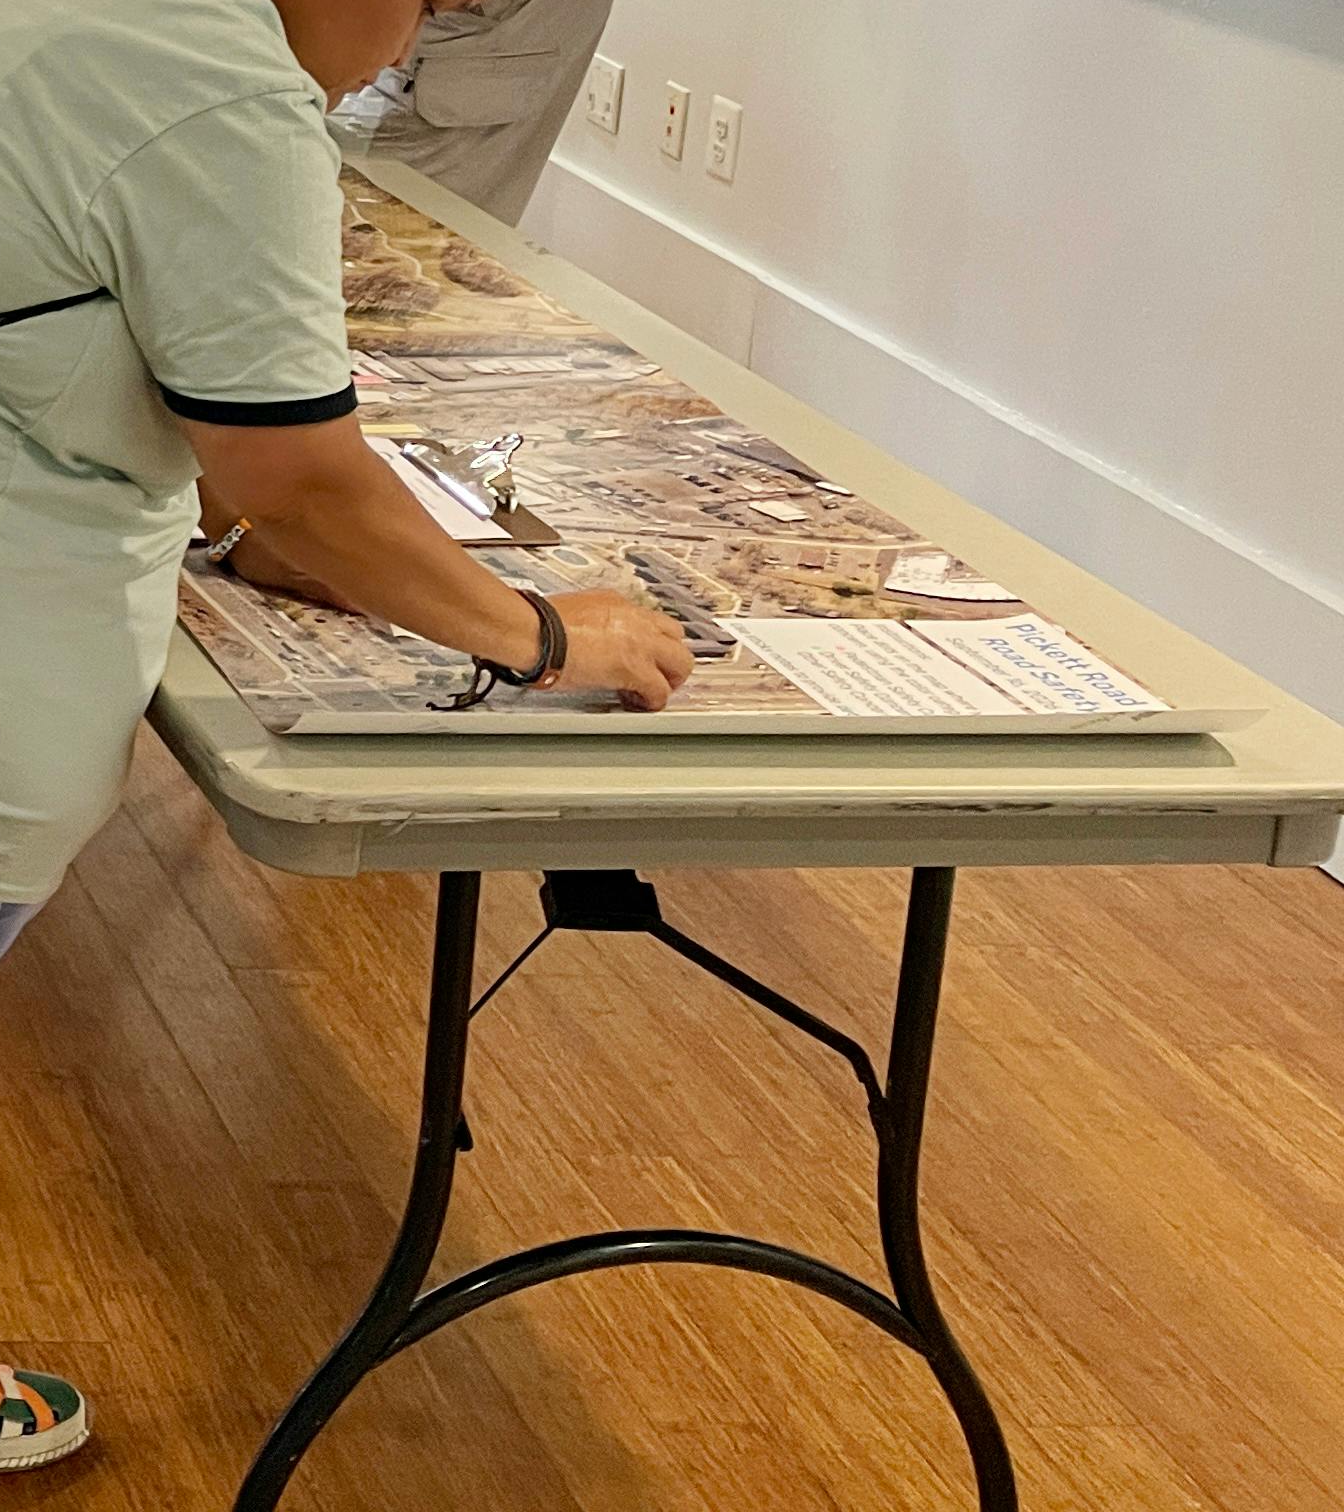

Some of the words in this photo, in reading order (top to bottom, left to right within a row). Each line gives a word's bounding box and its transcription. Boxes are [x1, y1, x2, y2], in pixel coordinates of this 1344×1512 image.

[978, 637, 1046, 668] Road
[1029, 671, 1100, 712] Safety
[1006, 623, 1091, 670] Pickett
[1076, 672, 1148, 706] Road
